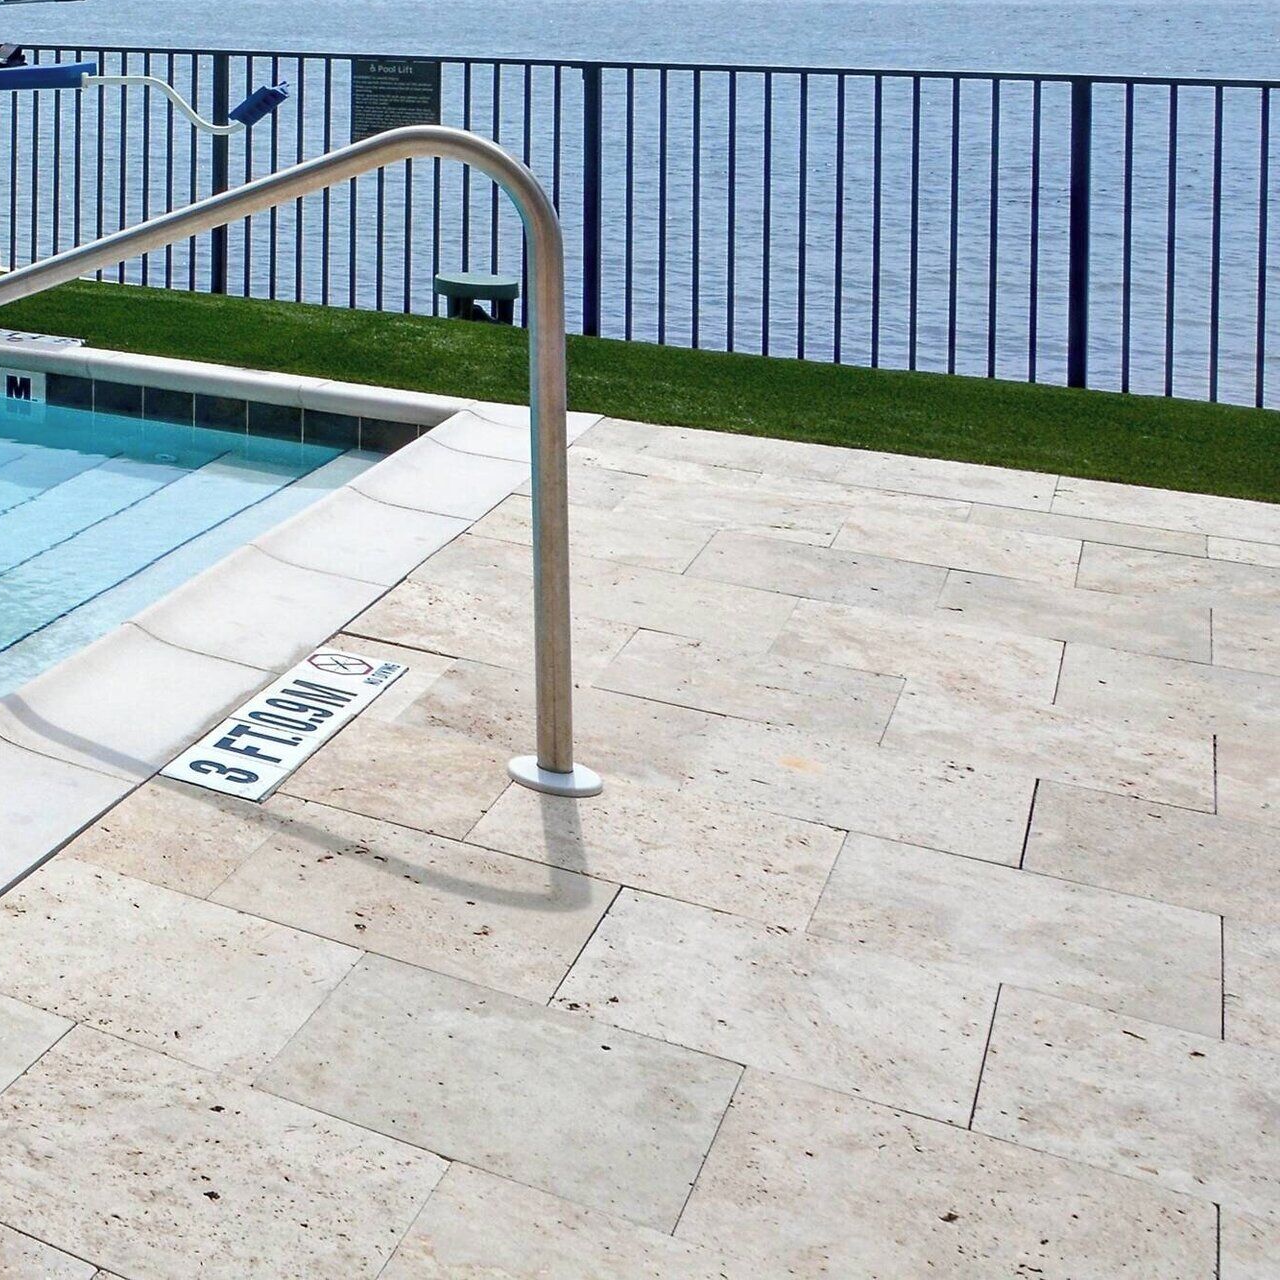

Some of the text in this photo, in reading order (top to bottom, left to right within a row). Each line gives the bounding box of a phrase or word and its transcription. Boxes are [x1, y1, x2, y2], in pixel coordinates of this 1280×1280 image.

[377, 65, 413, 74] Pool Lift
[189, 759, 260, 784] 3
